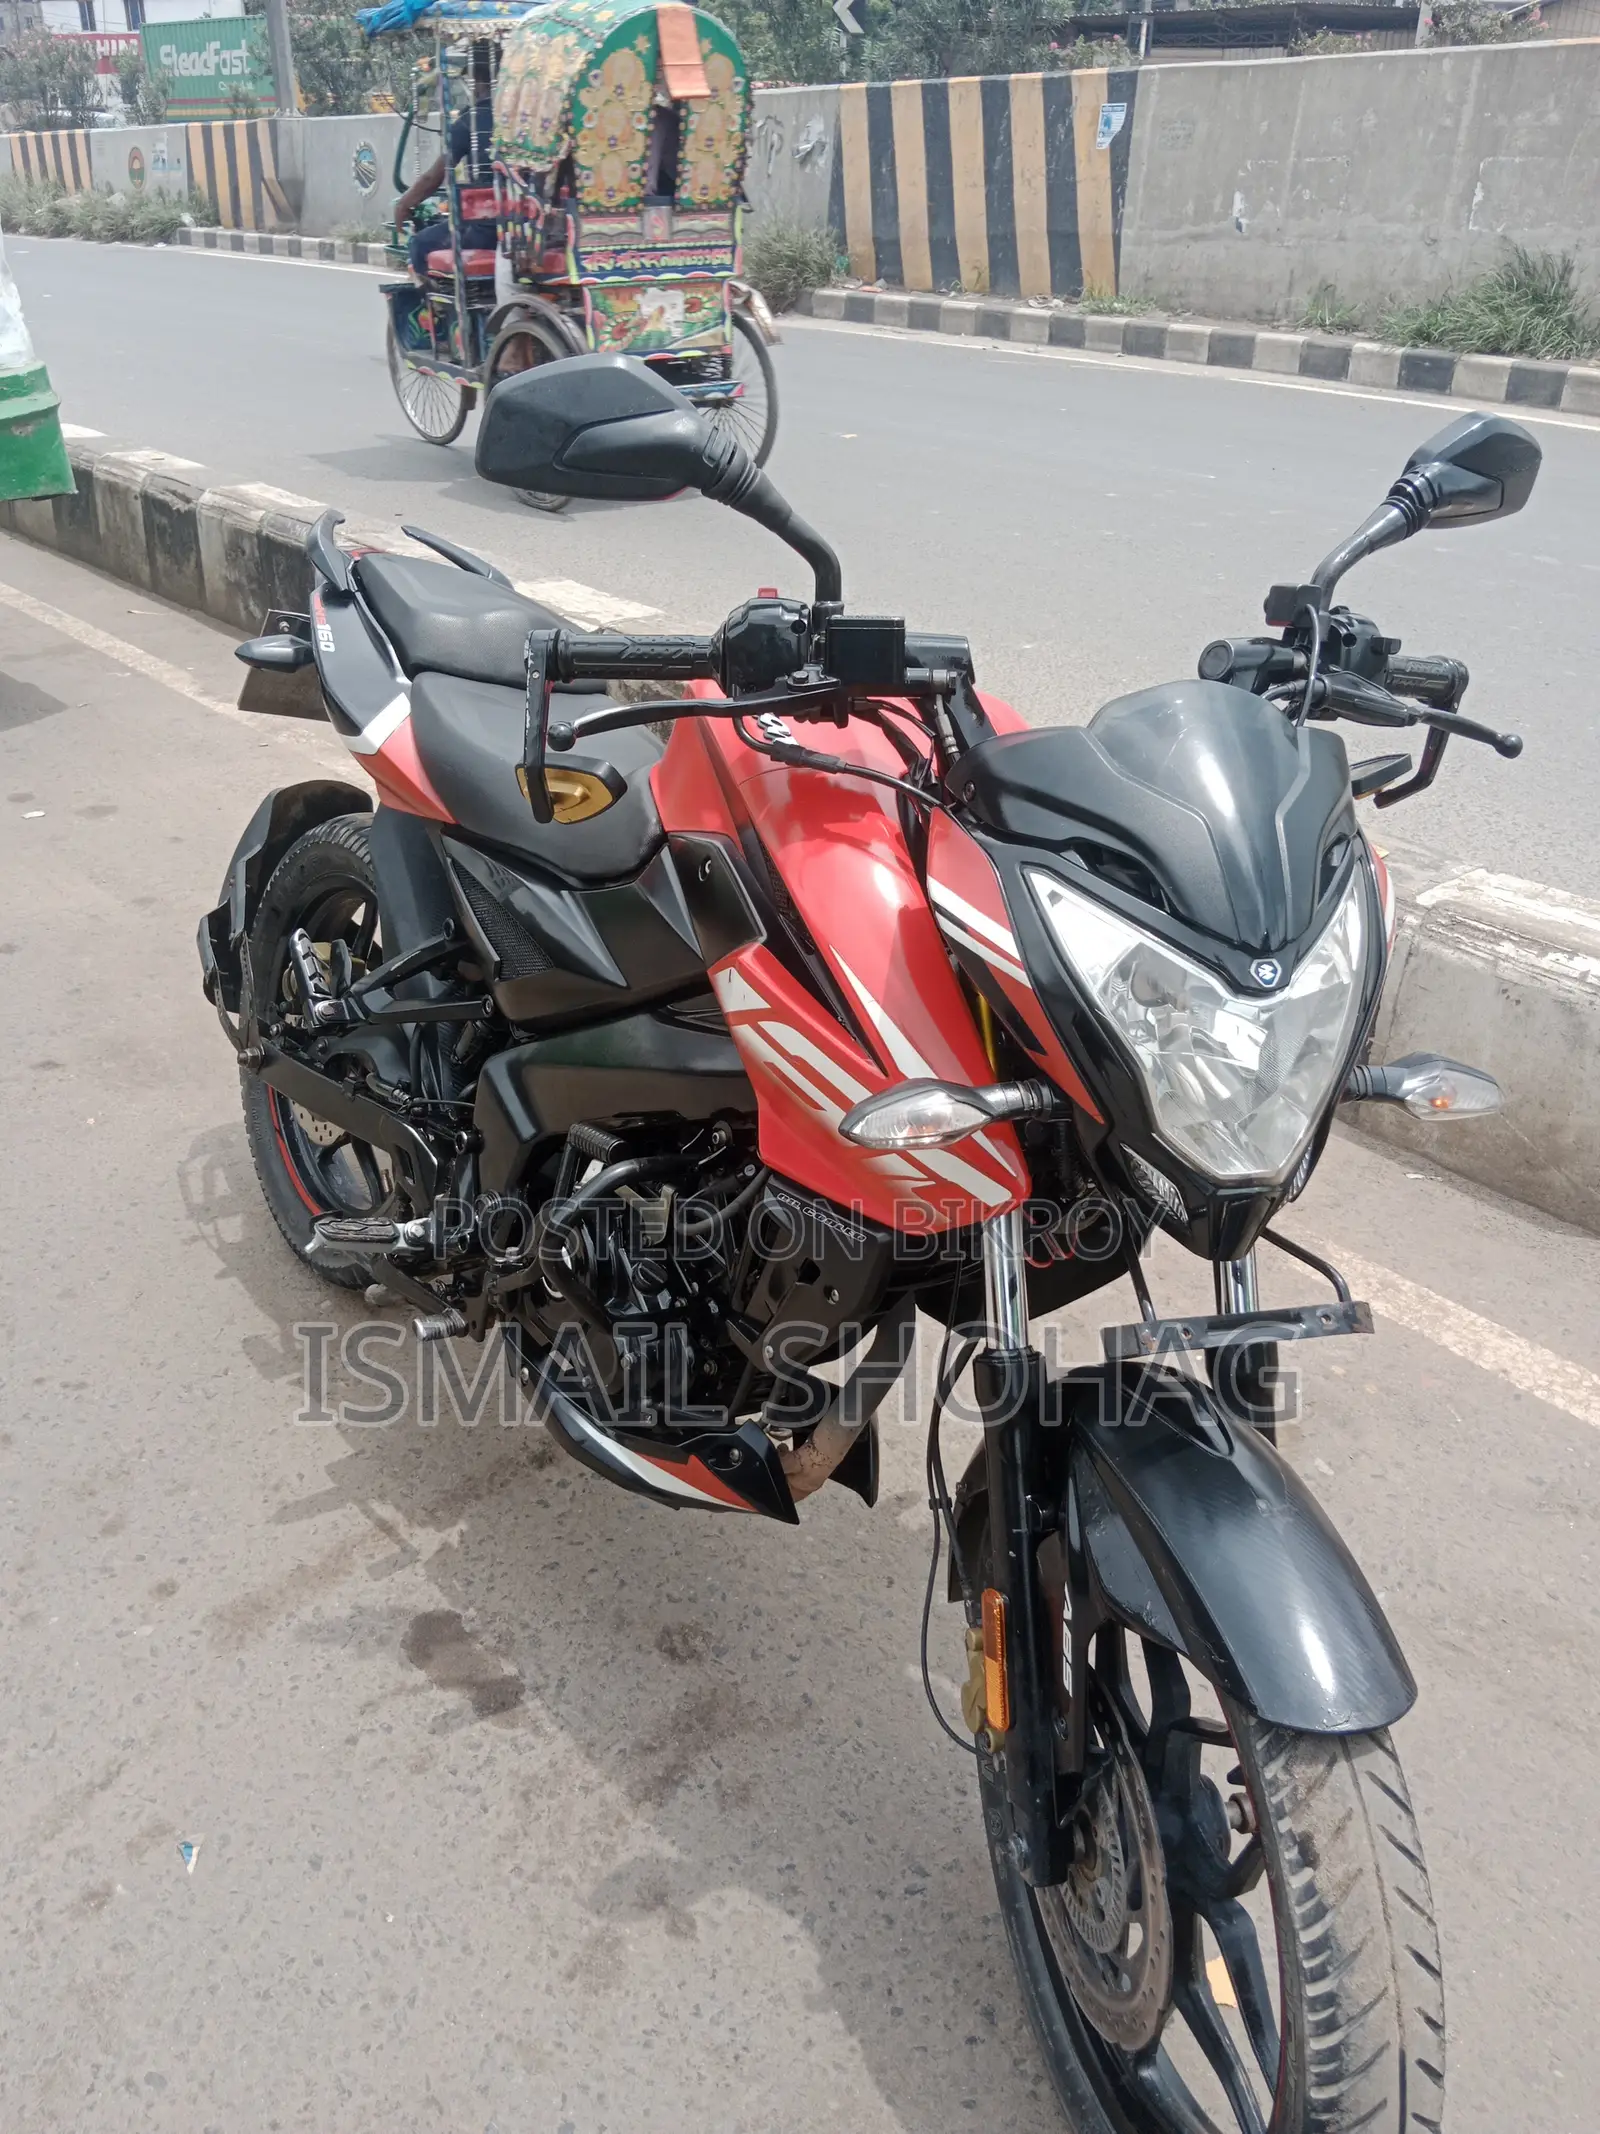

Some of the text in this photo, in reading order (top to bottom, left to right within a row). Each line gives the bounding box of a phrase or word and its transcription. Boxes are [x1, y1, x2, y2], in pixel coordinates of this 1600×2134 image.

[159, 39, 252, 77] SteadFast
[777, 1193, 867, 1242] OIL COOLED
[1062, 1581, 1072, 1698] ABS
